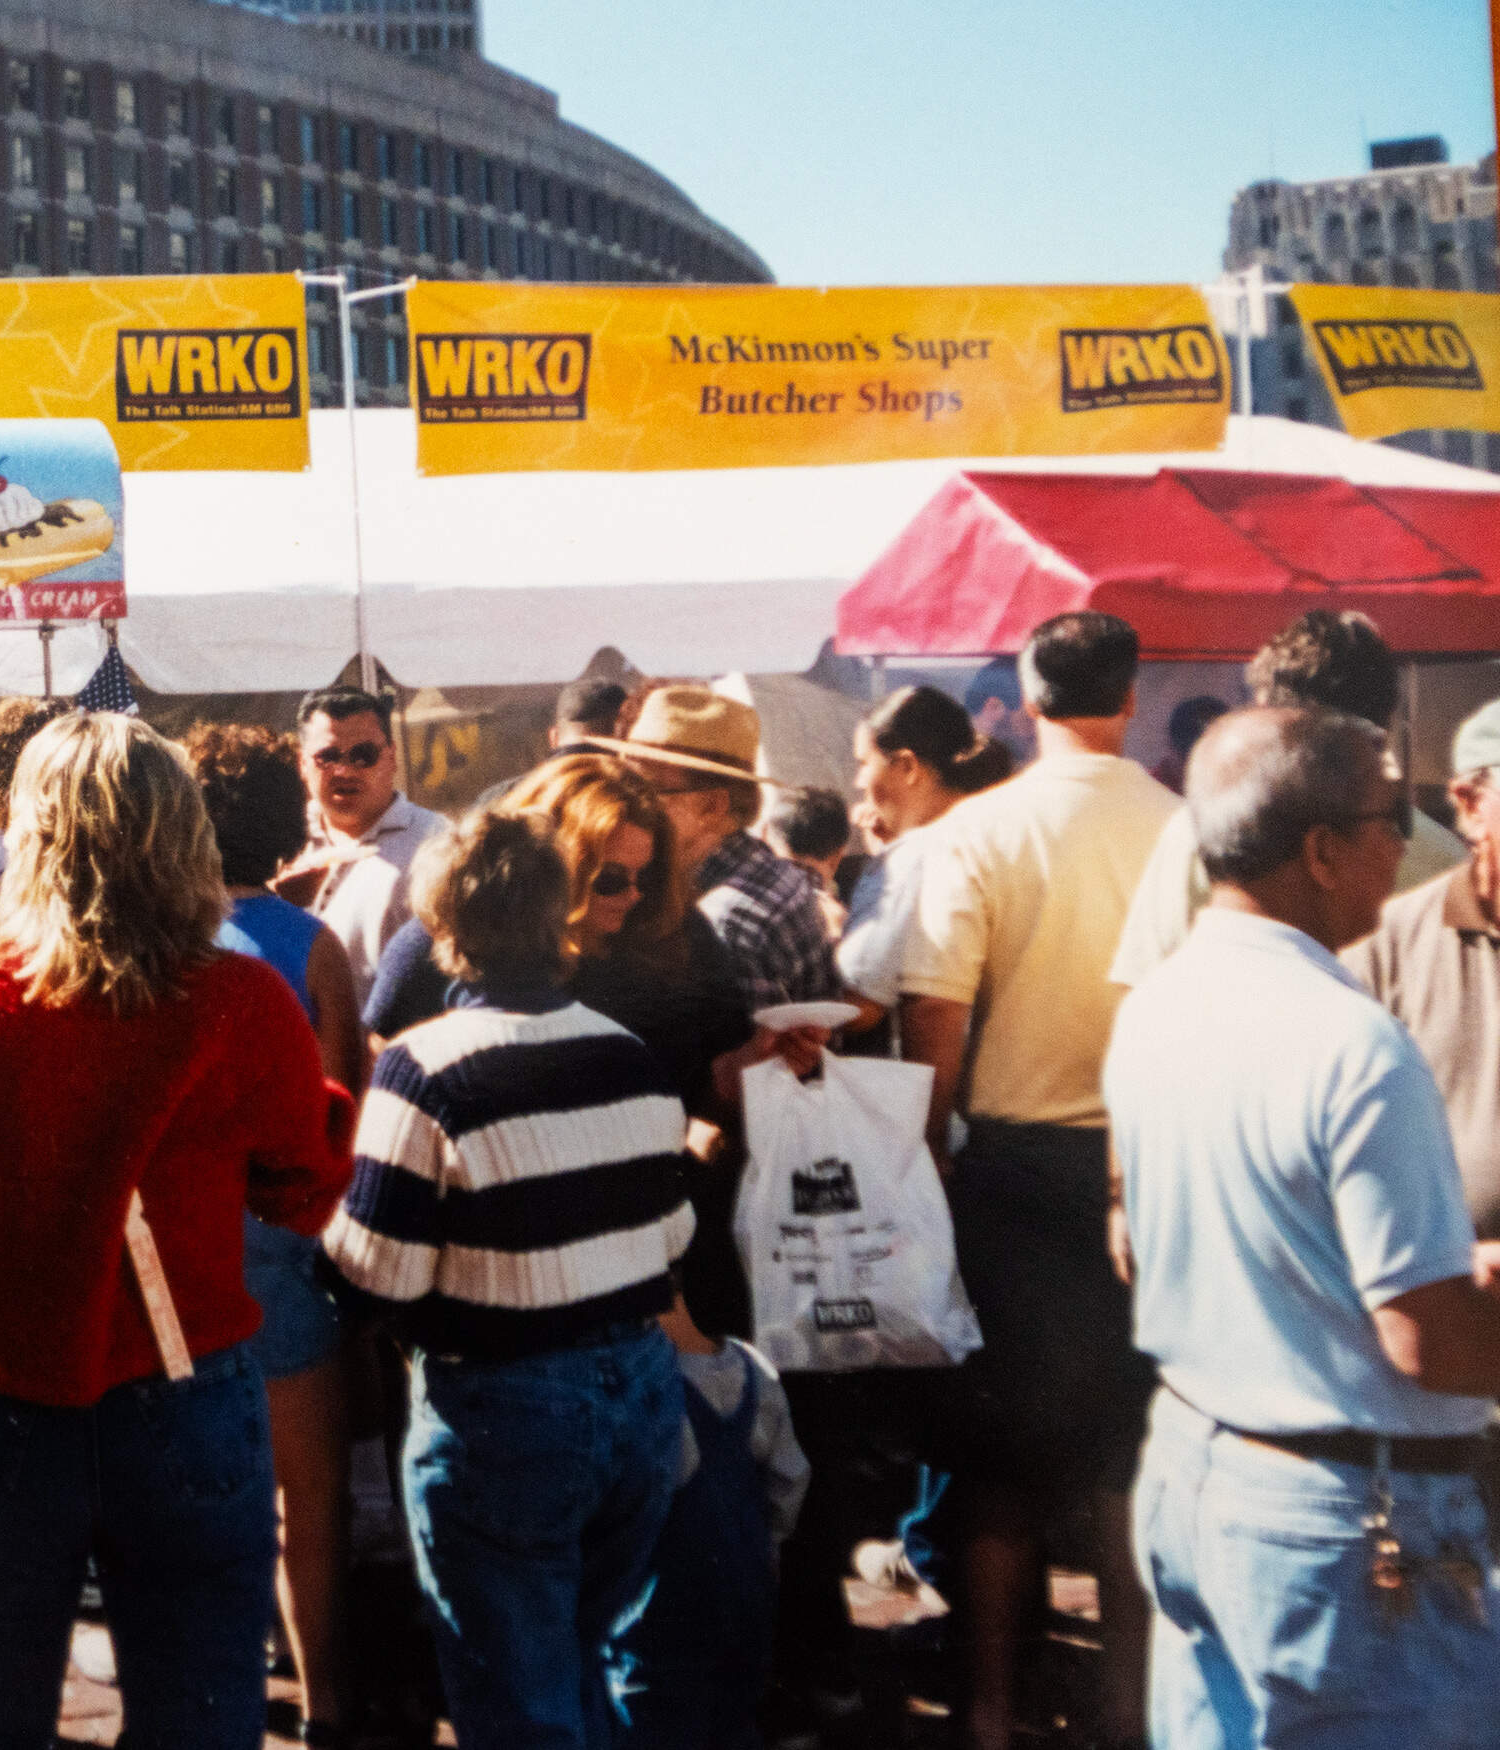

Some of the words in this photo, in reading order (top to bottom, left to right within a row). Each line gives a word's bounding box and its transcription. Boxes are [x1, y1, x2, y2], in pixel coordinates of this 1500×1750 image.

[122, 333, 293, 394] WRKO
[419, 339, 584, 397] WRKO
[668, 332, 881, 364] McKinnon's
[892, 331, 993, 370] Super
[1064, 329, 1216, 389] WRKO
[1320, 325, 1471, 370] WRKO
[125, 405, 150, 417] The
[155, 405, 182, 416] Talk
[699, 381, 845, 415] Butcher
[858, 380, 963, 422] Shops
[30, 589, 98, 606] CREAM
